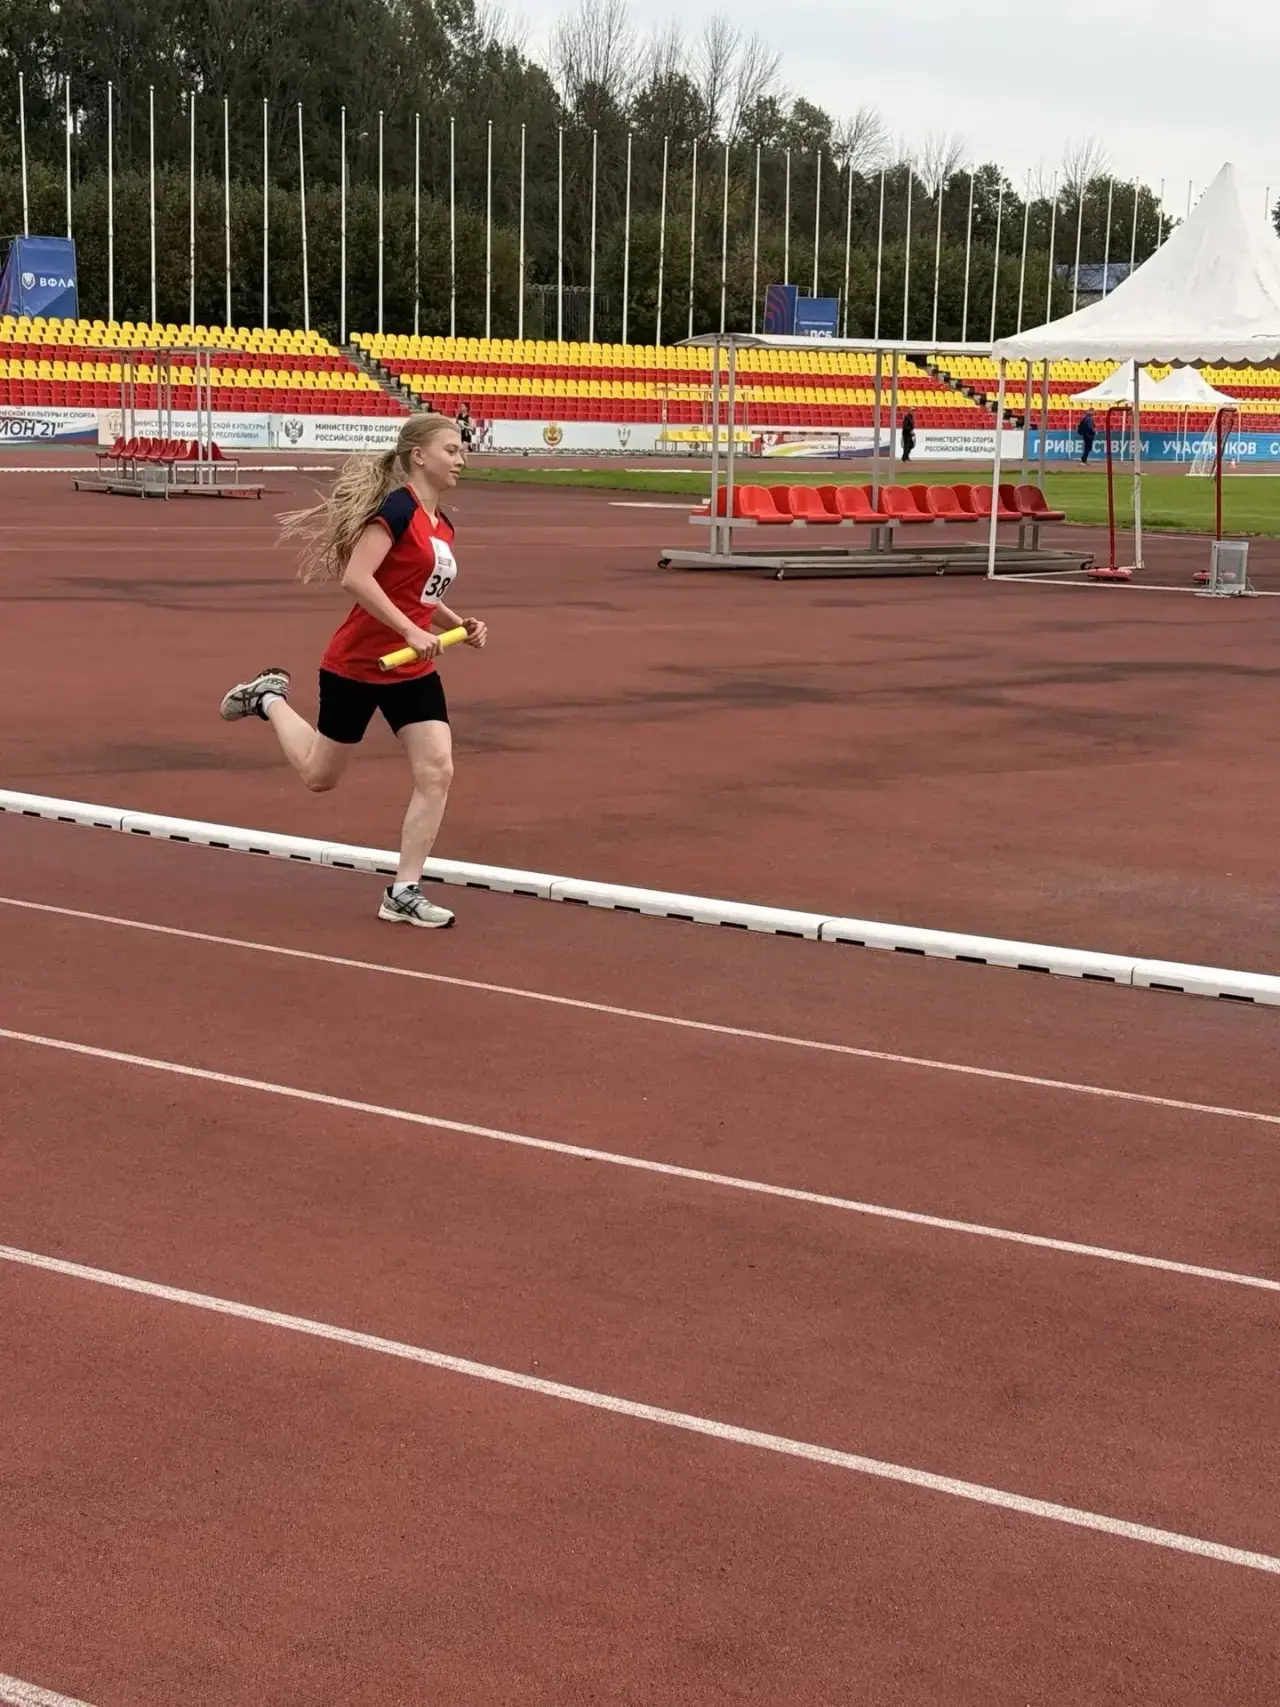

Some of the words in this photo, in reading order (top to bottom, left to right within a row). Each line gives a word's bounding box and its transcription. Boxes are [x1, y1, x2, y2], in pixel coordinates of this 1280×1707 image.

[40, 277, 75, 288] ВФЛА
[232, 422, 266, 430] КУЛЬТУРЫ
[315, 423, 373, 432] МИНИСТЕРСТВО
[315, 433, 363, 442] РОССИЙСКОЙ
[1033, 439, 1150, 453] ПРИВЕСТВУЕМ
[1269, 442, 1280, 455] С
[425, 574, 451, 598] 38
